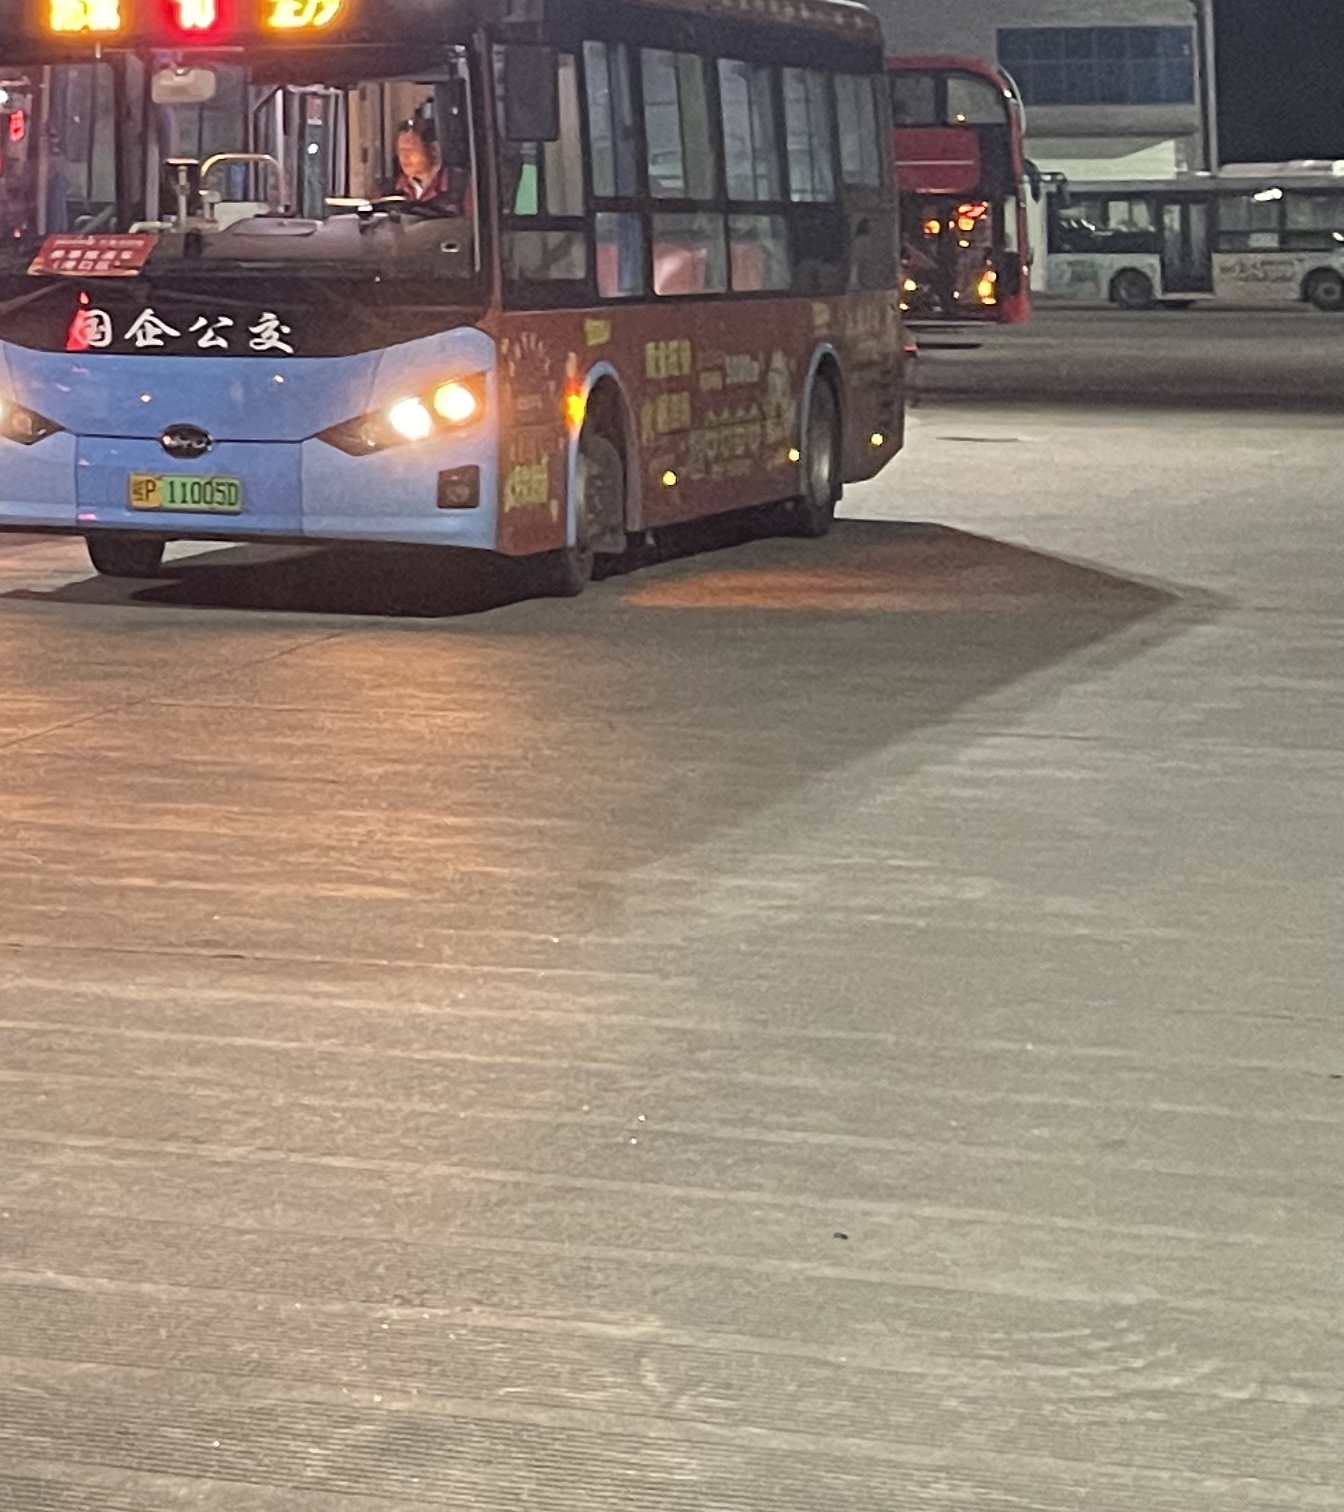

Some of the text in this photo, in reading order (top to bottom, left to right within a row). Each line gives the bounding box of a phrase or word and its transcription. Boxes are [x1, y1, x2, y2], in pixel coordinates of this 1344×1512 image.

[76, 307, 294, 355] 国企公交
[168, 480, 239, 506] 11005D
